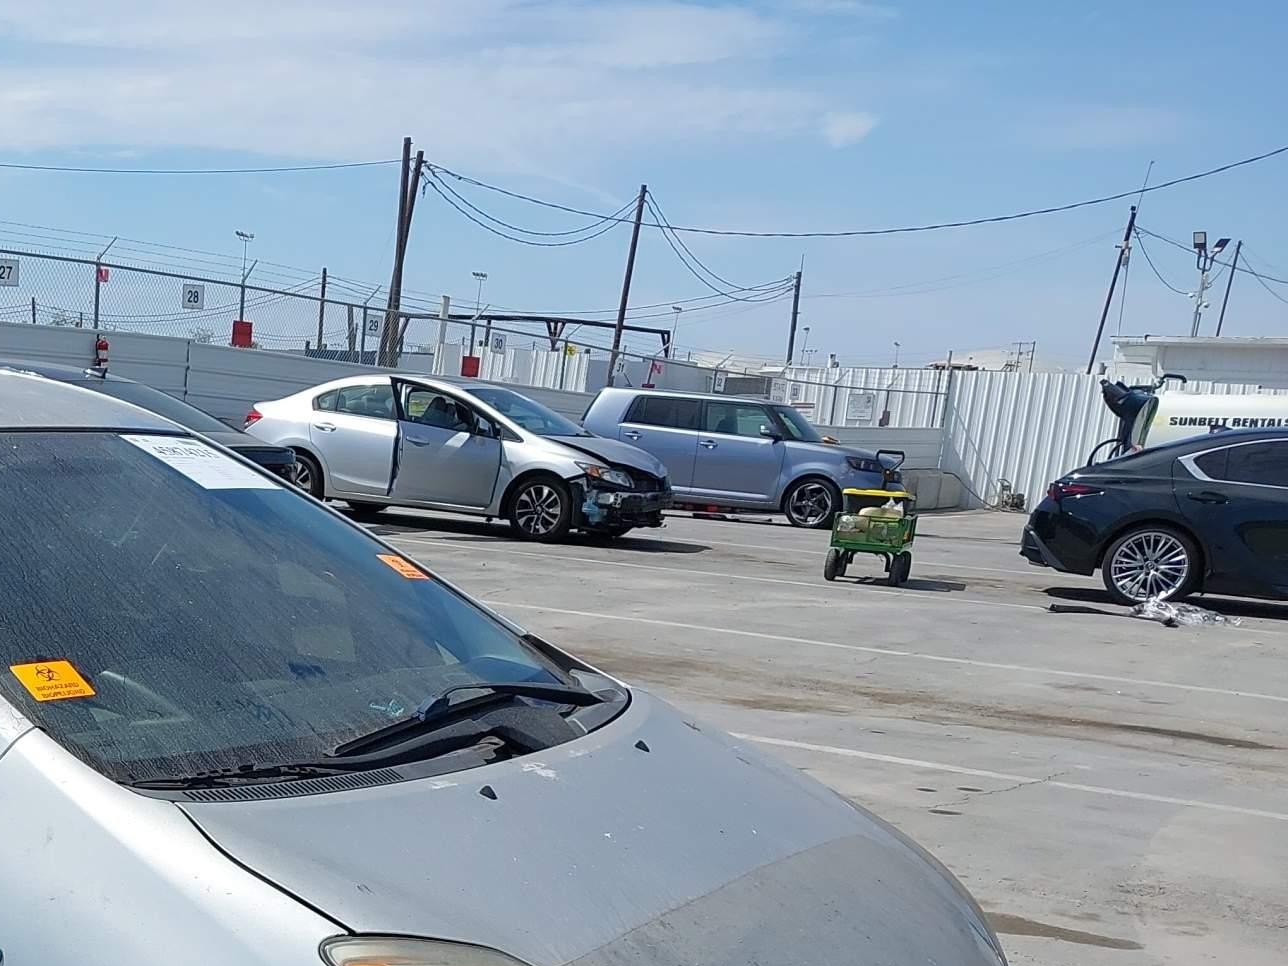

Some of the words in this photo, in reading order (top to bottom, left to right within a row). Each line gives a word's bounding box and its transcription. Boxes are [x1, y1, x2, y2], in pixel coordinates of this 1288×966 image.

[187, 291, 199, 304] 28
[368, 318, 379, 332] 29
[494, 337, 503, 350] 30
[1169, 416, 1229, 427] SUNBELT
[36, 682, 80, 692] BIOHAZARD
